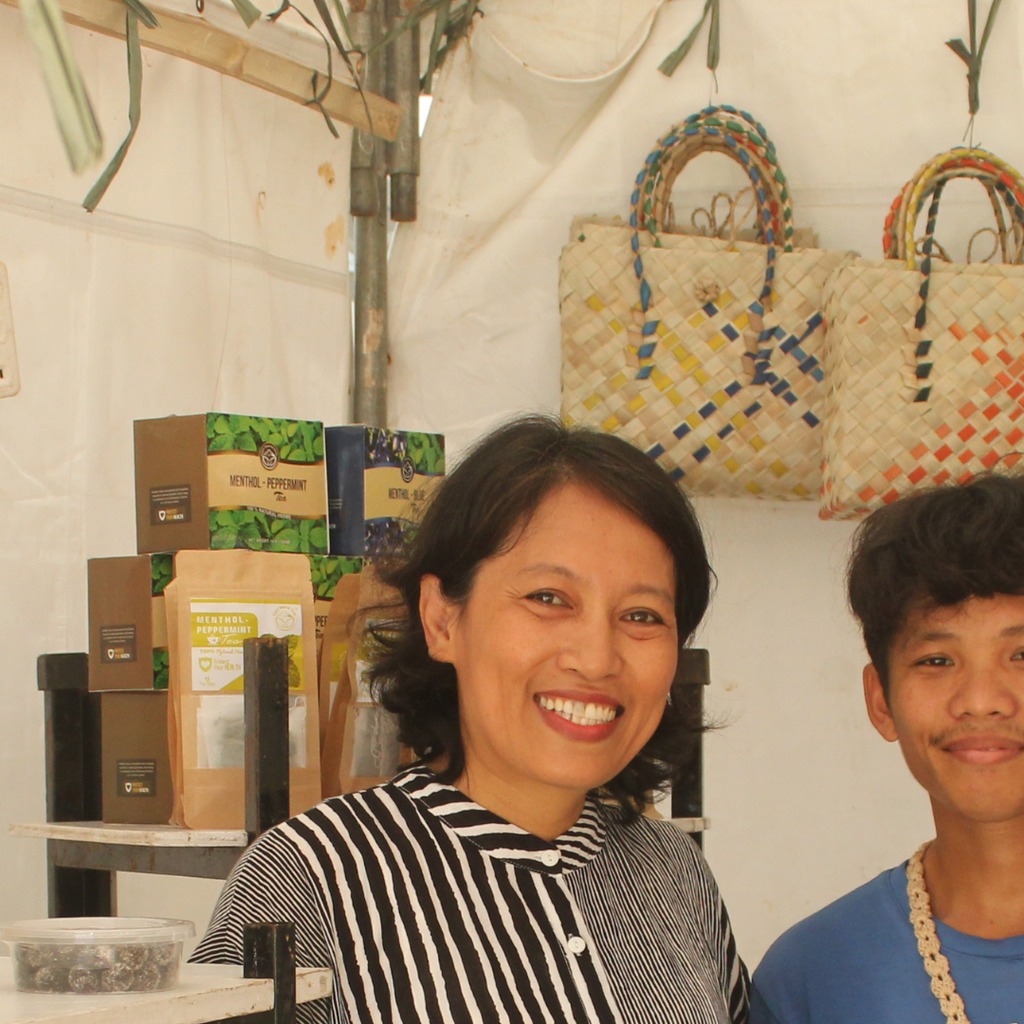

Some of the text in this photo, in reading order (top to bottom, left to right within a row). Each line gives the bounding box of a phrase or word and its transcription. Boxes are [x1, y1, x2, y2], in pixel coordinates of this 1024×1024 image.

[230, 475, 261, 488] MENTHOL
[266, 478, 307, 491] PEPPERMINT
[196, 616, 249, 624] MENTHOL-
[196, 626, 252, 634] PEPPERMINT
